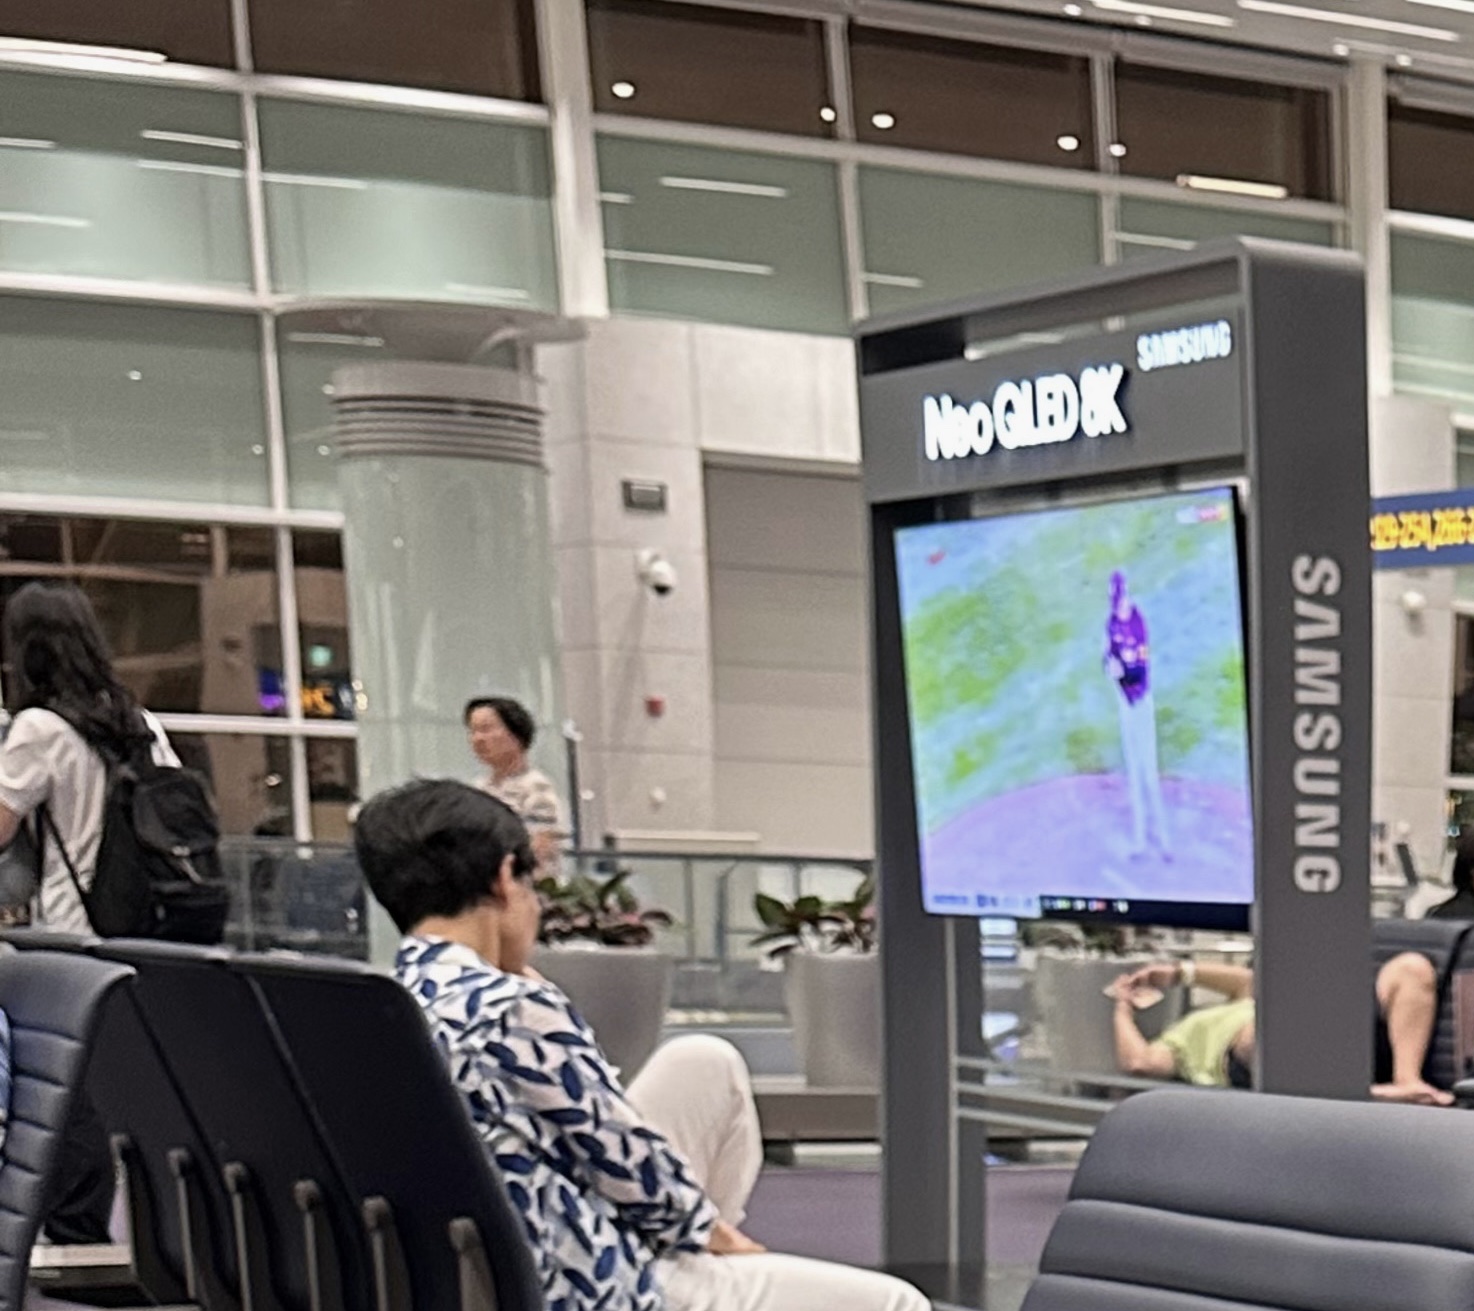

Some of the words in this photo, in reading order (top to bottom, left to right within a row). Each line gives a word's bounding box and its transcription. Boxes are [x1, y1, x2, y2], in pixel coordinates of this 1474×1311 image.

[1136, 319, 1231, 372] SAMSUNG
[923, 394, 994, 461] Neo
[993, 373, 1079, 450] QLED
[1079, 363, 1127, 438] 8K
[1291, 554, 1342, 893] SAMSUNG
